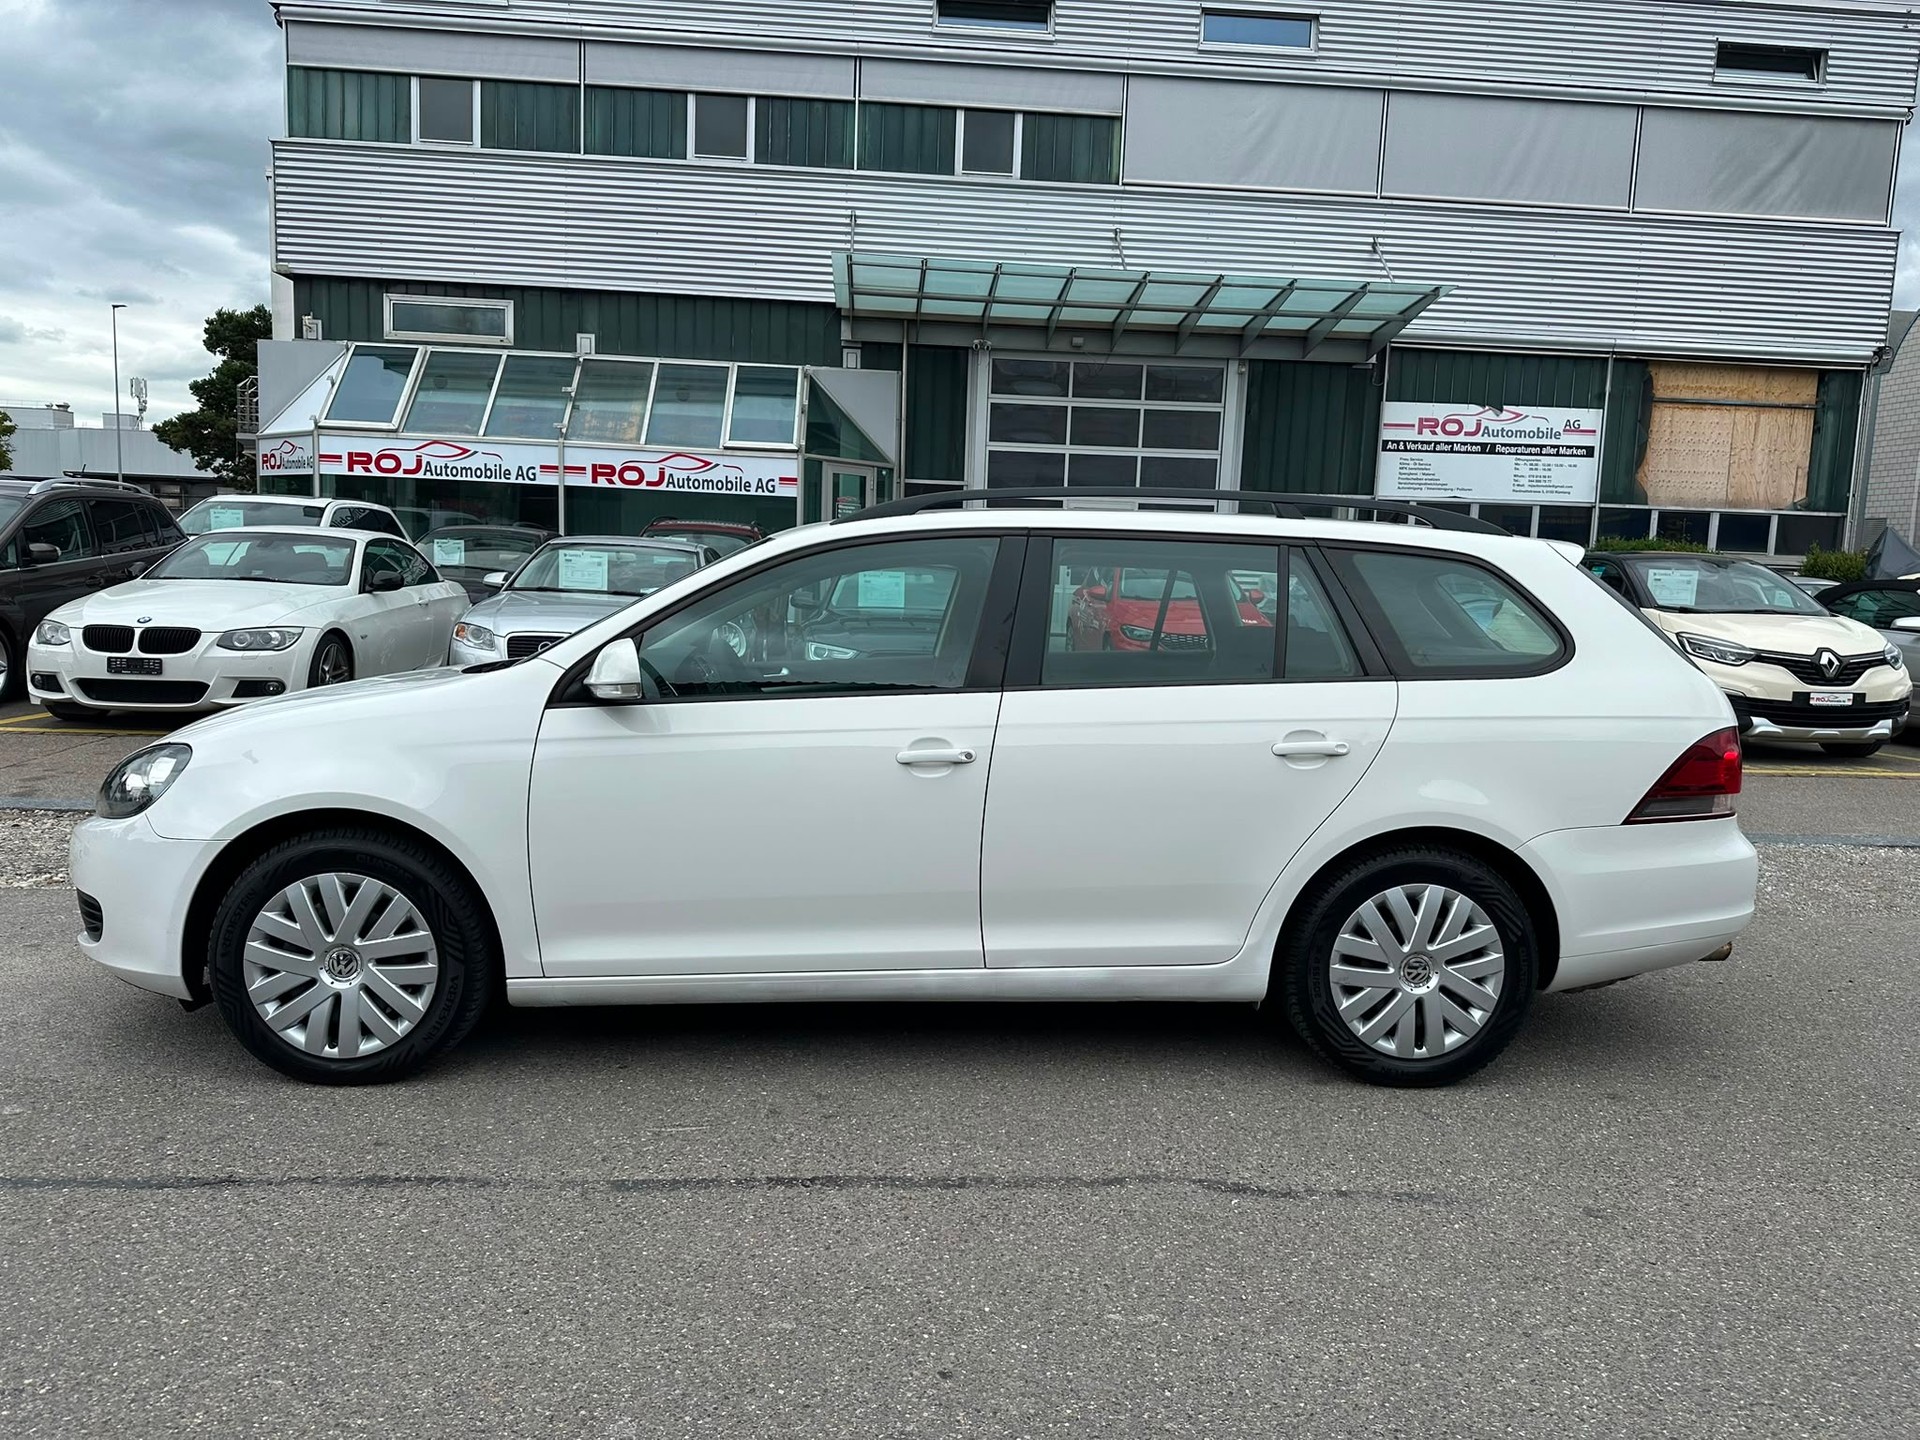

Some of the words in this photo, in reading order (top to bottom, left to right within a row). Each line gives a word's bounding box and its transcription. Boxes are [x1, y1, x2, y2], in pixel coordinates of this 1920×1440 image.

[1417, 417, 1482, 437] ROJ
[1481, 425, 1562, 440] Automobile
[1564, 419, 1581, 430] AG
[1387, 442, 1397, 450] An
[1398, 443, 1405, 451] &
[1406, 442, 1434, 451] Verkauf
[1434, 443, 1452, 452] aller
[1453, 443, 1481, 453] Marken
[1495, 445, 1541, 455] Reparaturen
[1541, 446, 1558, 455] aller
[1559, 447, 1587, 456] Marken
[261, 452, 282, 470] ROJ
[347, 451, 423, 475] ROJ
[423, 460, 511, 481] Automobile
[515, 465, 537, 482] AG
[591, 463, 665, 487] ROJ
[666, 473, 751, 493] Automobile
[755, 478, 776, 494] AG
